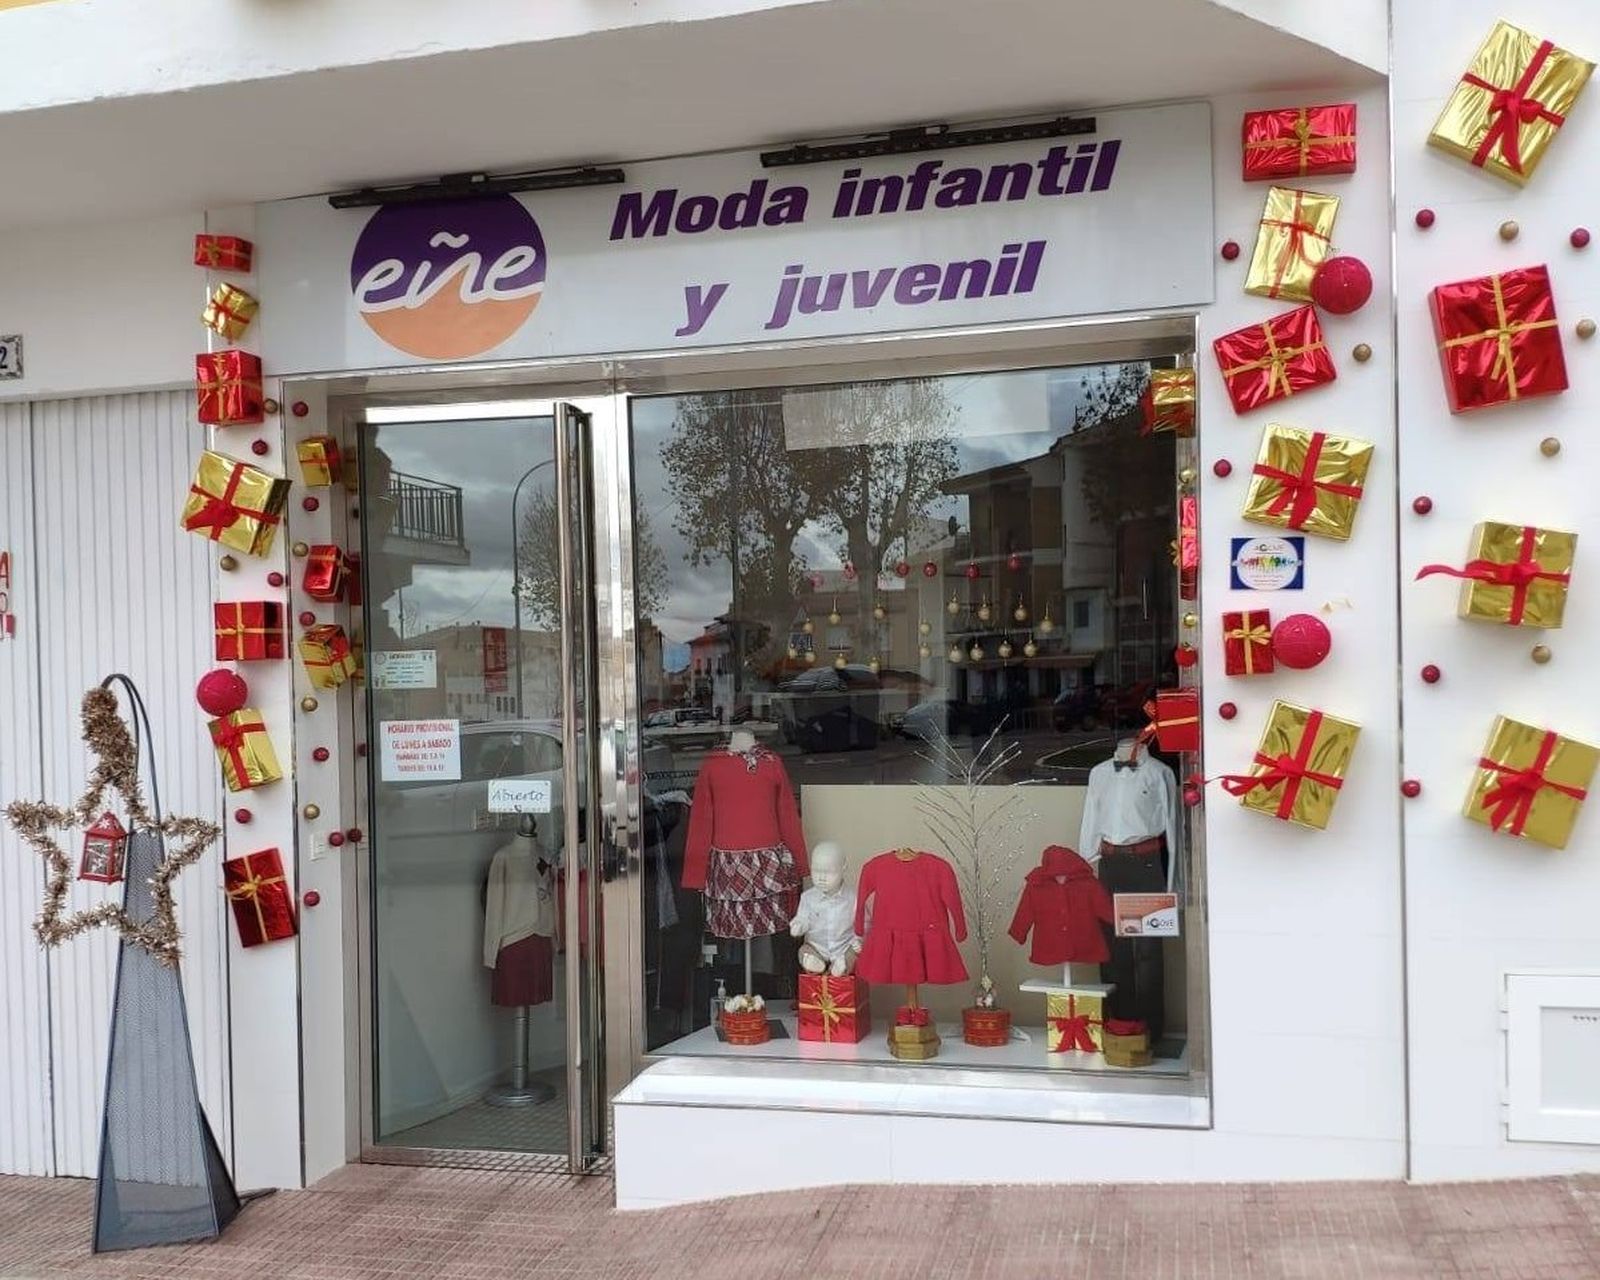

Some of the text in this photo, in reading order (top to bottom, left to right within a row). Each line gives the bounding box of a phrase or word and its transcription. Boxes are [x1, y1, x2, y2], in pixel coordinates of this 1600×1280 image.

[609, 139, 1122, 241] Moda infantil
[355, 231, 546, 313] eñe
[675, 240, 1047, 337] y juvenil
[415, 722, 455, 733] PROVISIONAL
[492, 788, 544, 801] Abierto
